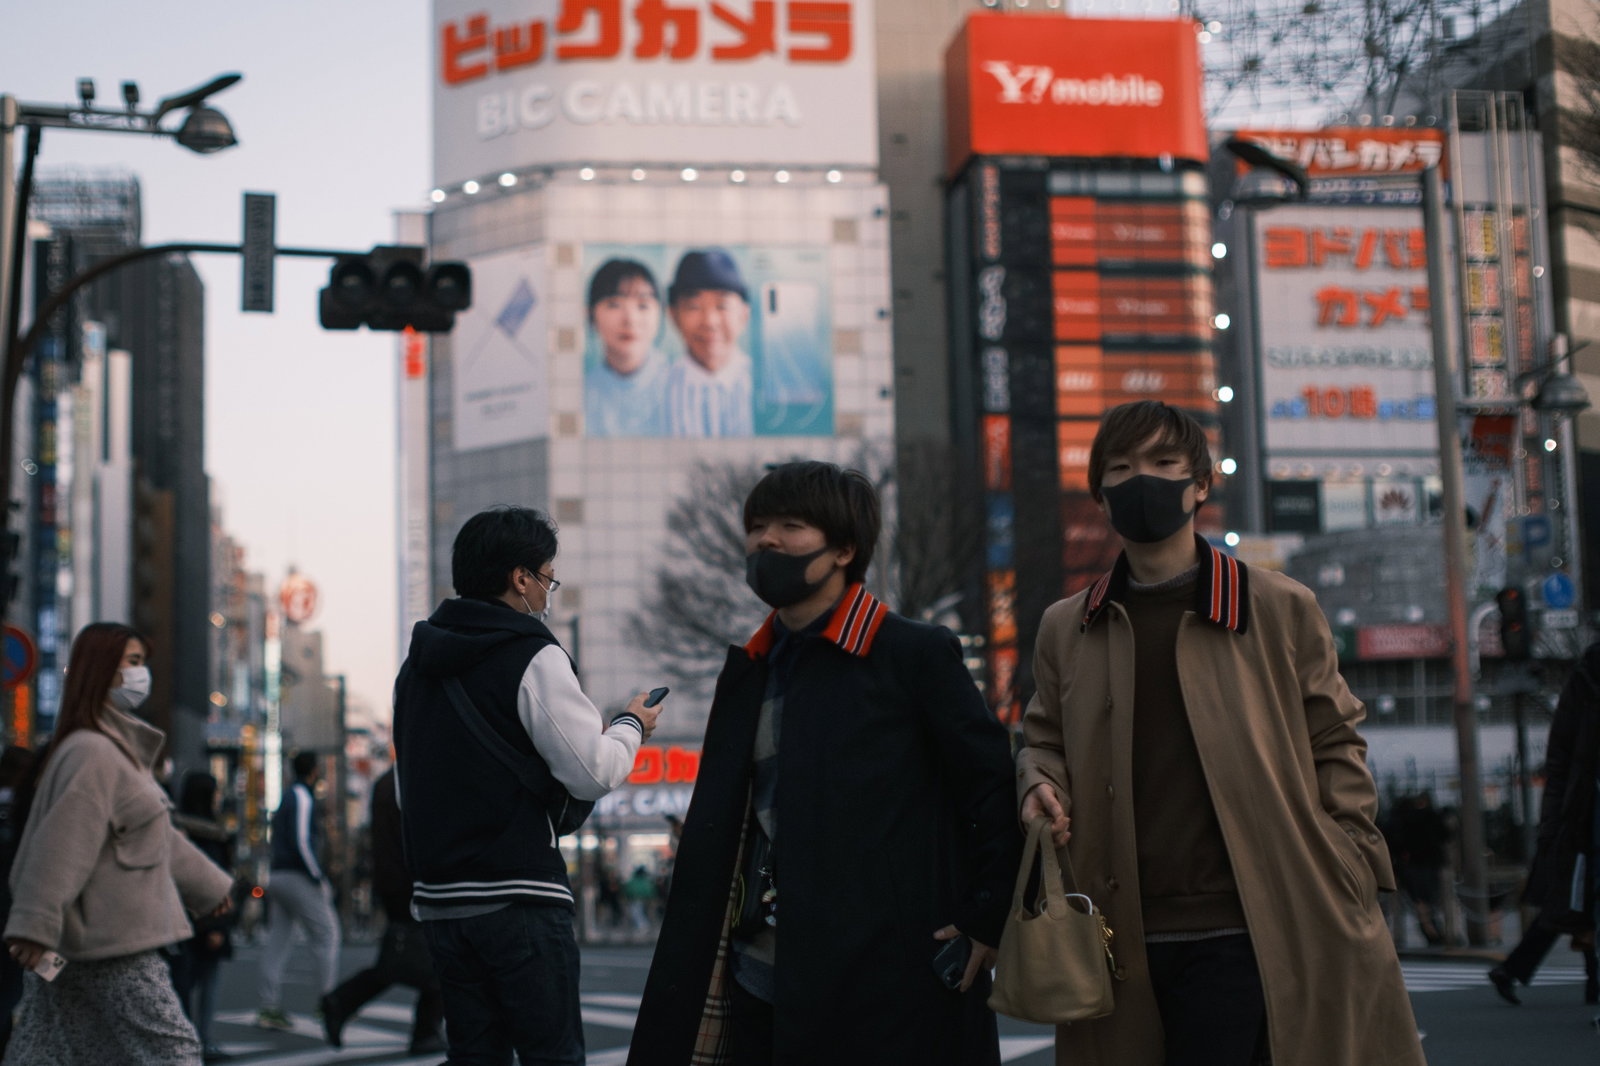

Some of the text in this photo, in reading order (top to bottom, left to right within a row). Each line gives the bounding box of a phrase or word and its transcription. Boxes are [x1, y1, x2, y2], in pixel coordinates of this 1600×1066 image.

[441, 0, 853, 85] ビックカメラ
[475, 79, 802, 140] BIC CAMERA
